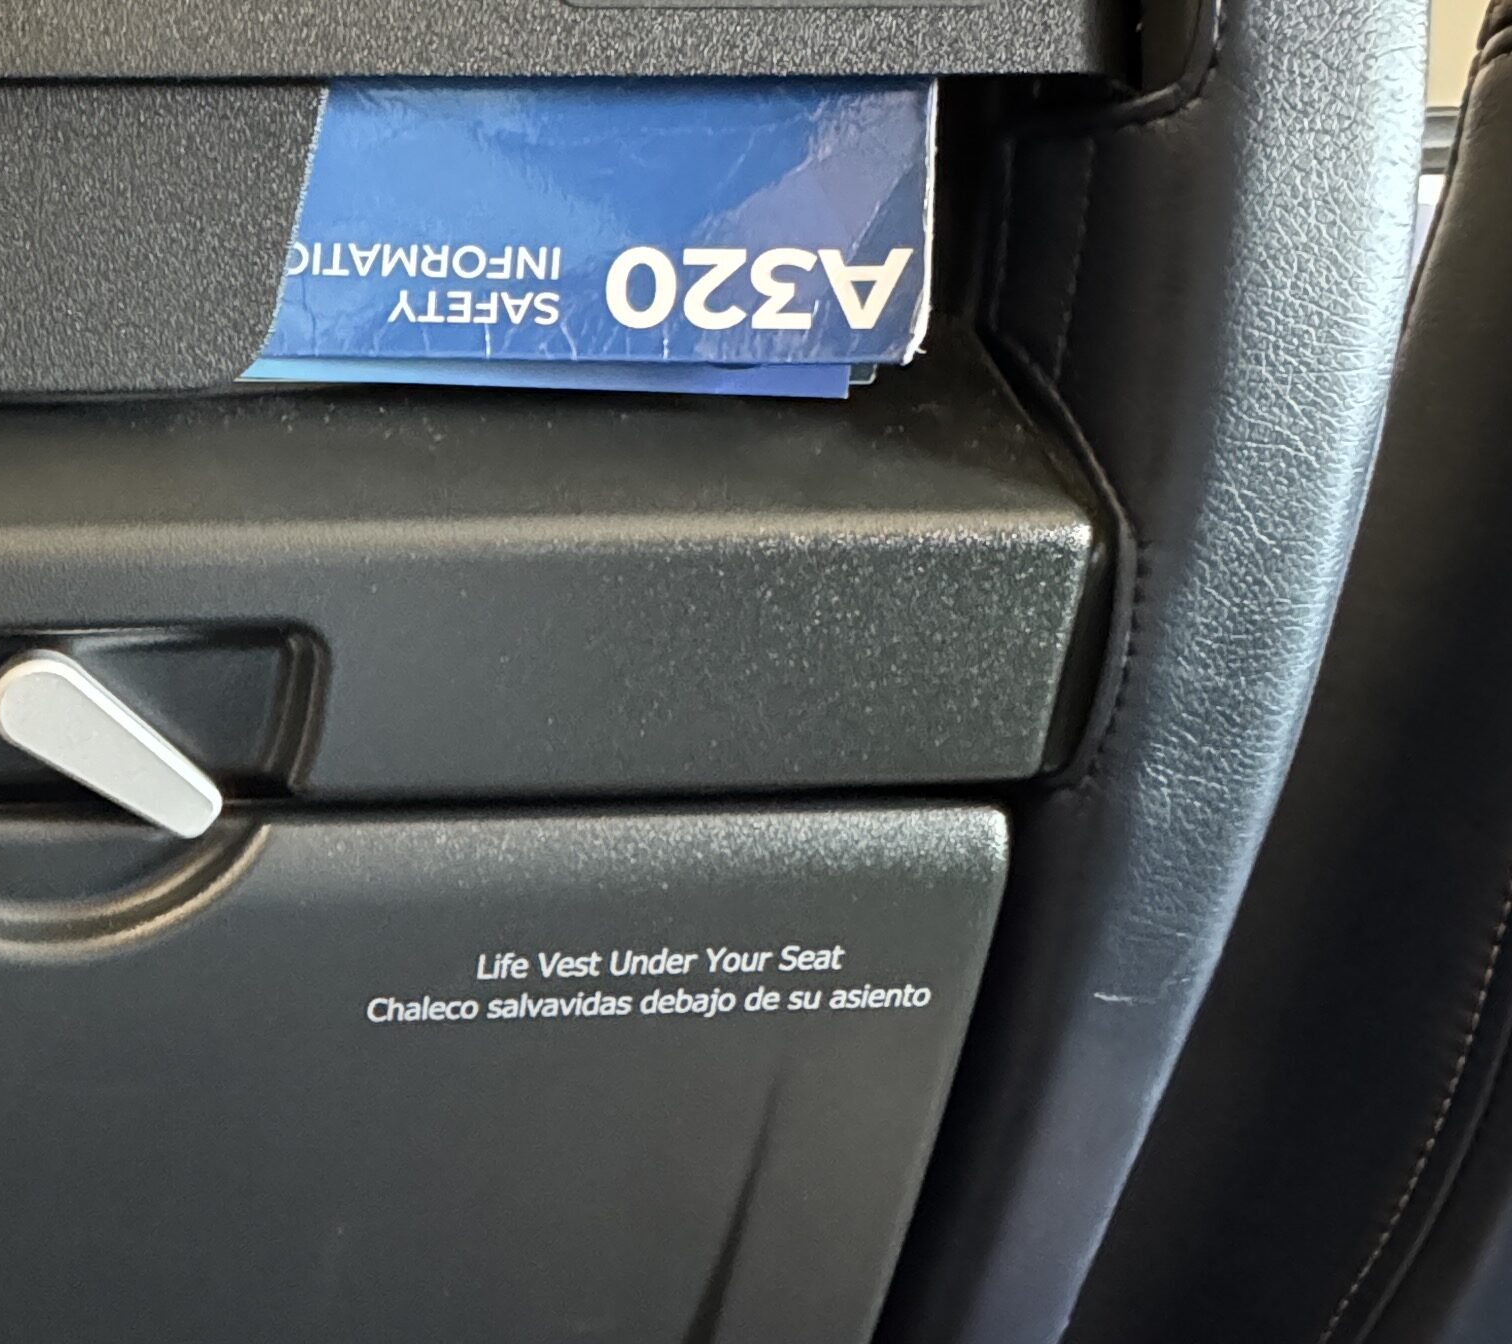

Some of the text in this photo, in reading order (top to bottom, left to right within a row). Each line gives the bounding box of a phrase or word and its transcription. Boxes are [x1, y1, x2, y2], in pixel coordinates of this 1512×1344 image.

[605, 246, 914, 331] A320
[388, 290, 560, 326] SAFETY
[476, 944, 845, 981] Life Vest Under Your Seat
[366, 983, 932, 1023] Chaleco salvavidas debajo de su asiento
